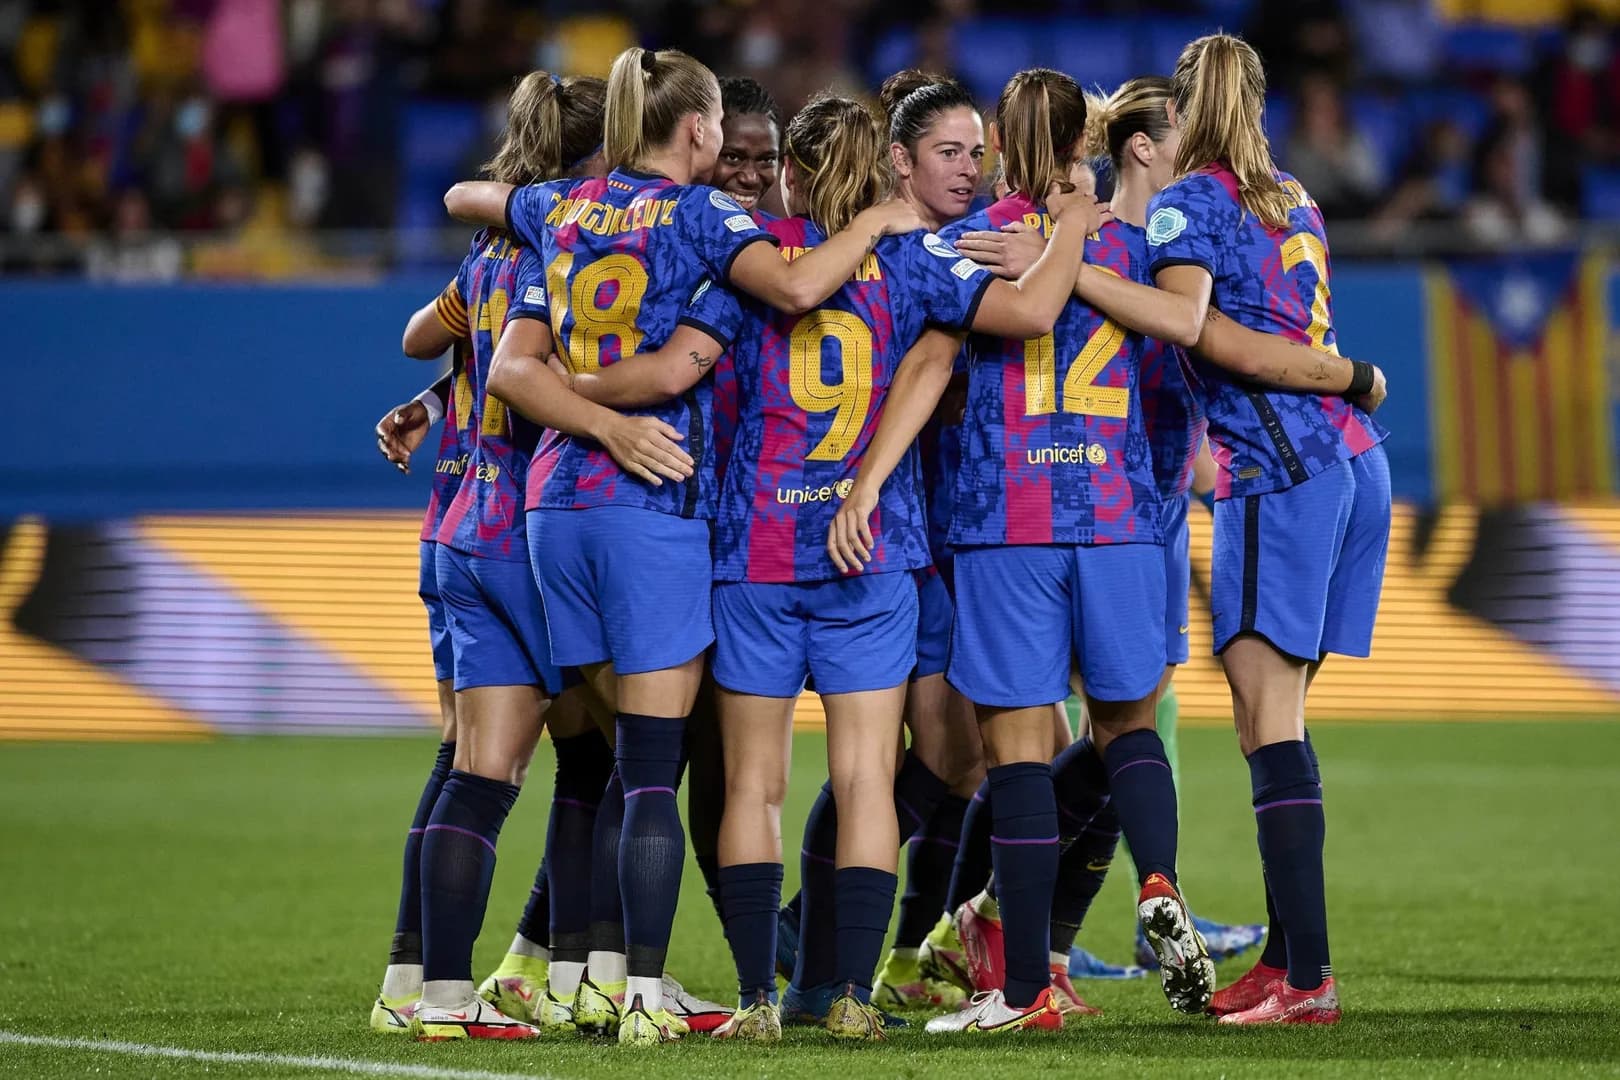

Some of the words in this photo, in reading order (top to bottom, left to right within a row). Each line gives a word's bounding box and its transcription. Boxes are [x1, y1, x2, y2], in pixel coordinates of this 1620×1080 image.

[546, 252, 649, 374] 18
[1023, 264, 1129, 418] 12
[1280, 232, 1339, 357] 2
[789, 309, 873, 461] 9
[776, 481, 838, 504] unicef
[1027, 442, 1084, 464] unicef
[1272, 997, 1315, 1022] ULTRA
